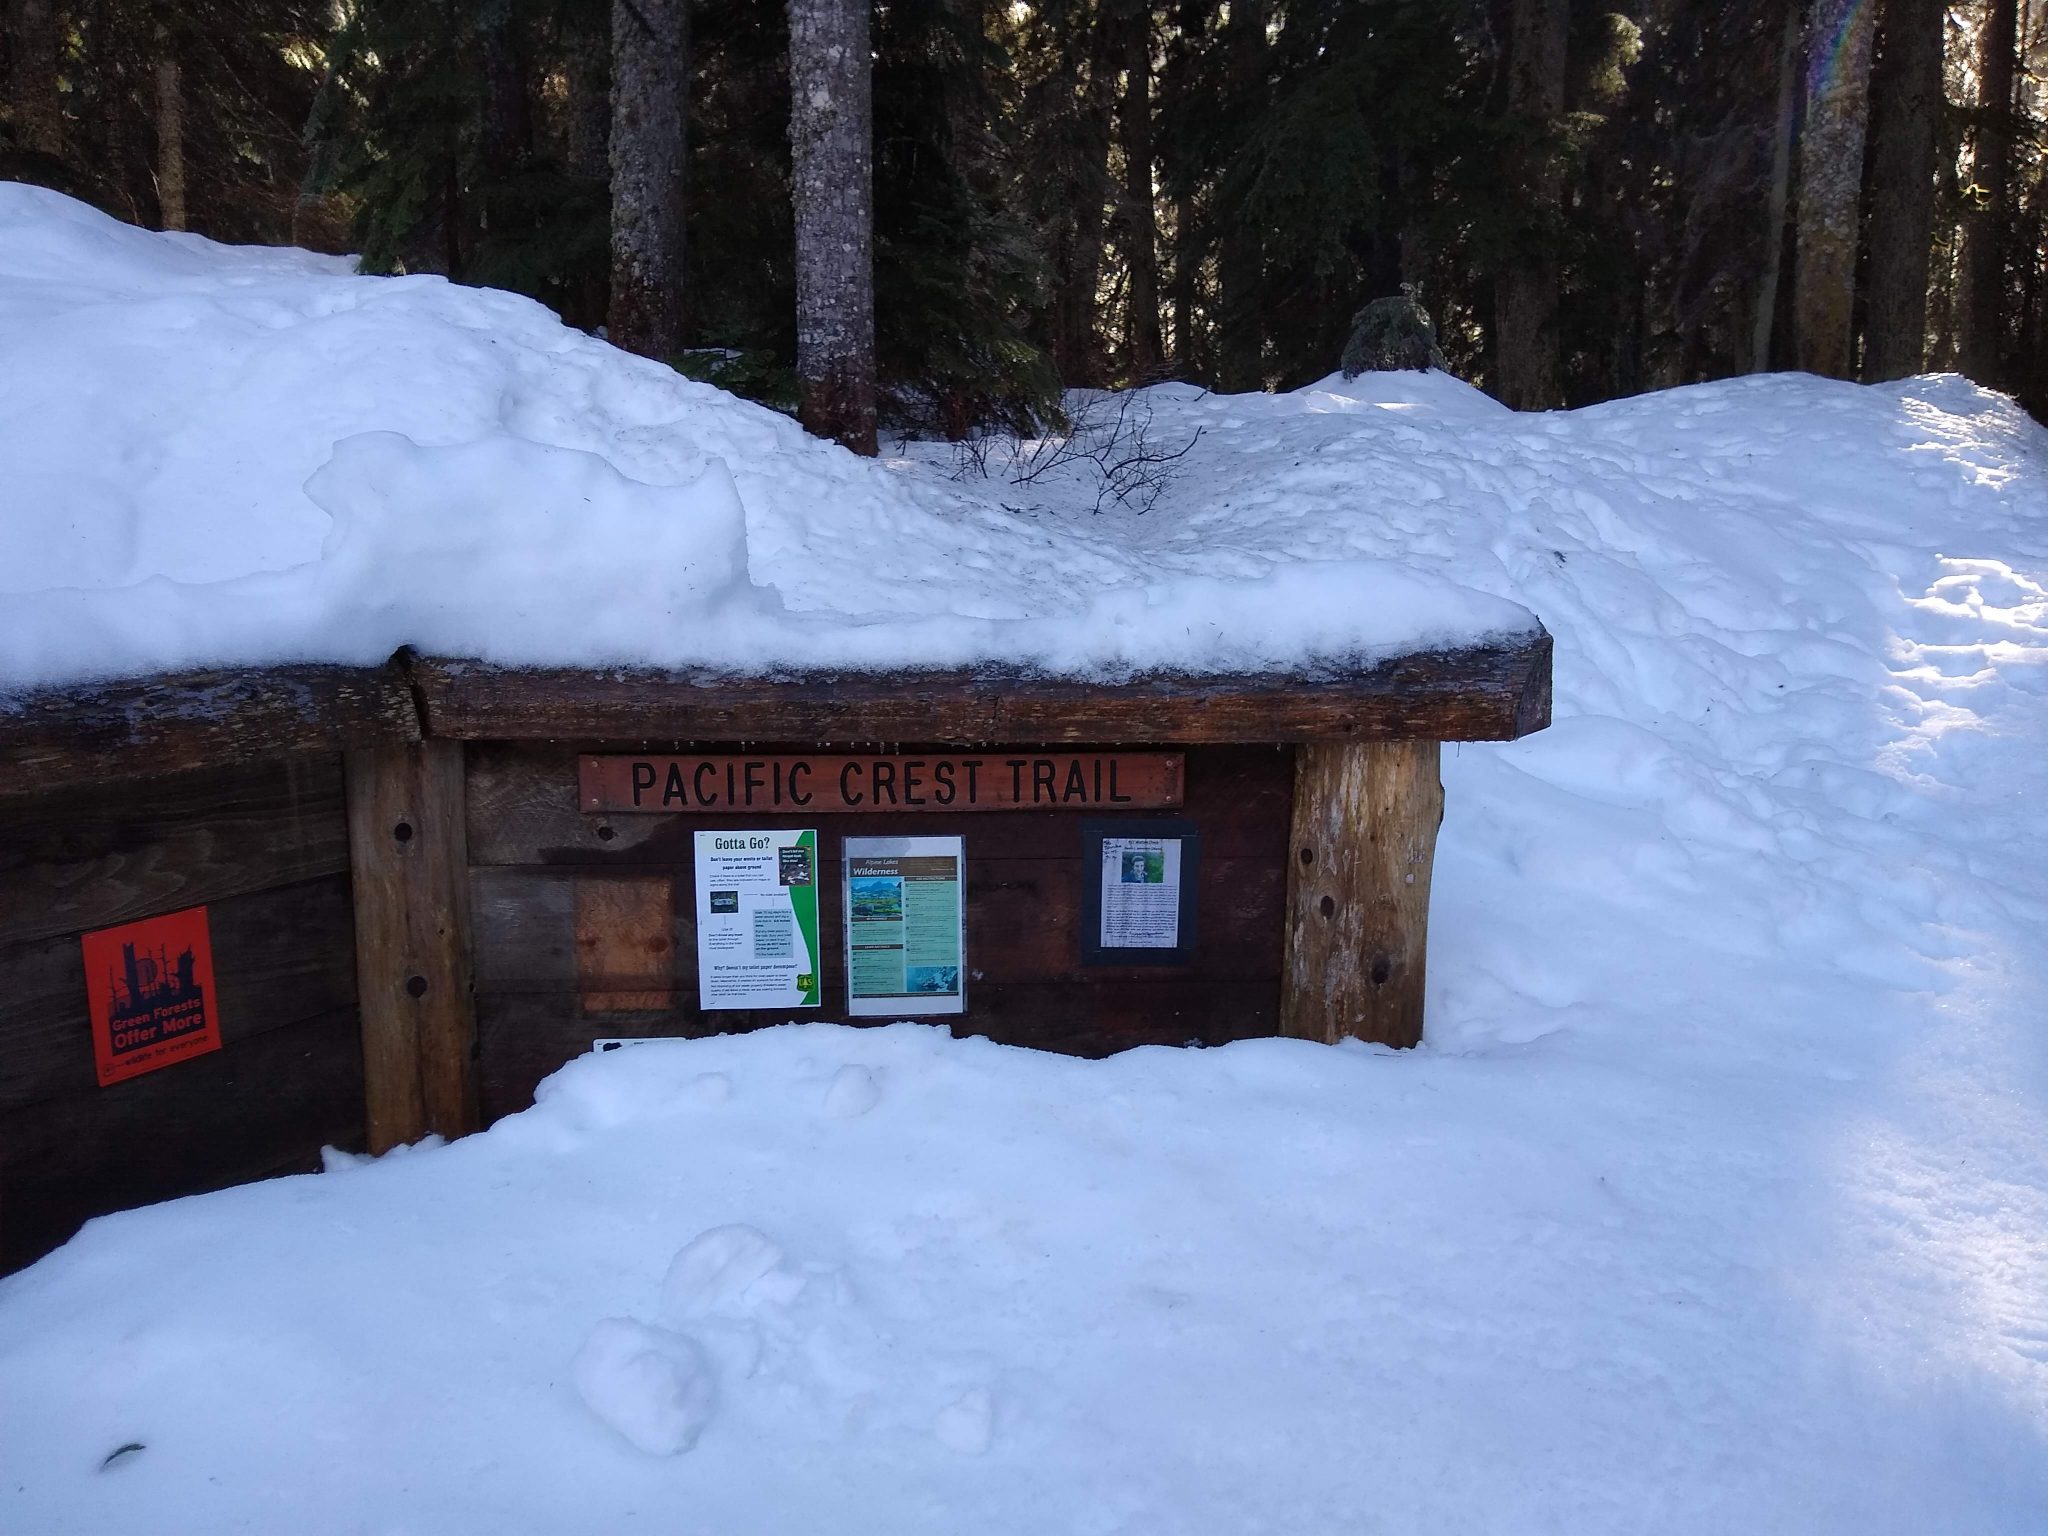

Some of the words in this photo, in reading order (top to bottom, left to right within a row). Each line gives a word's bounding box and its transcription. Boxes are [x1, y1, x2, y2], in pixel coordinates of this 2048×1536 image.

[632, 761, 813, 806] PACIFIC
[840, 760, 984, 805] CREST
[1006, 759, 1132, 804] TRAIL
[715, 837, 746, 850] Gotta
[749, 836, 770, 850] Go?
[852, 867, 899, 876] Wilderness
[112, 1013, 151, 1031] Green
[153, 998, 201, 1019] Forests
[114, 1026, 157, 1049] Offer
[162, 1013, 202, 1034] More
